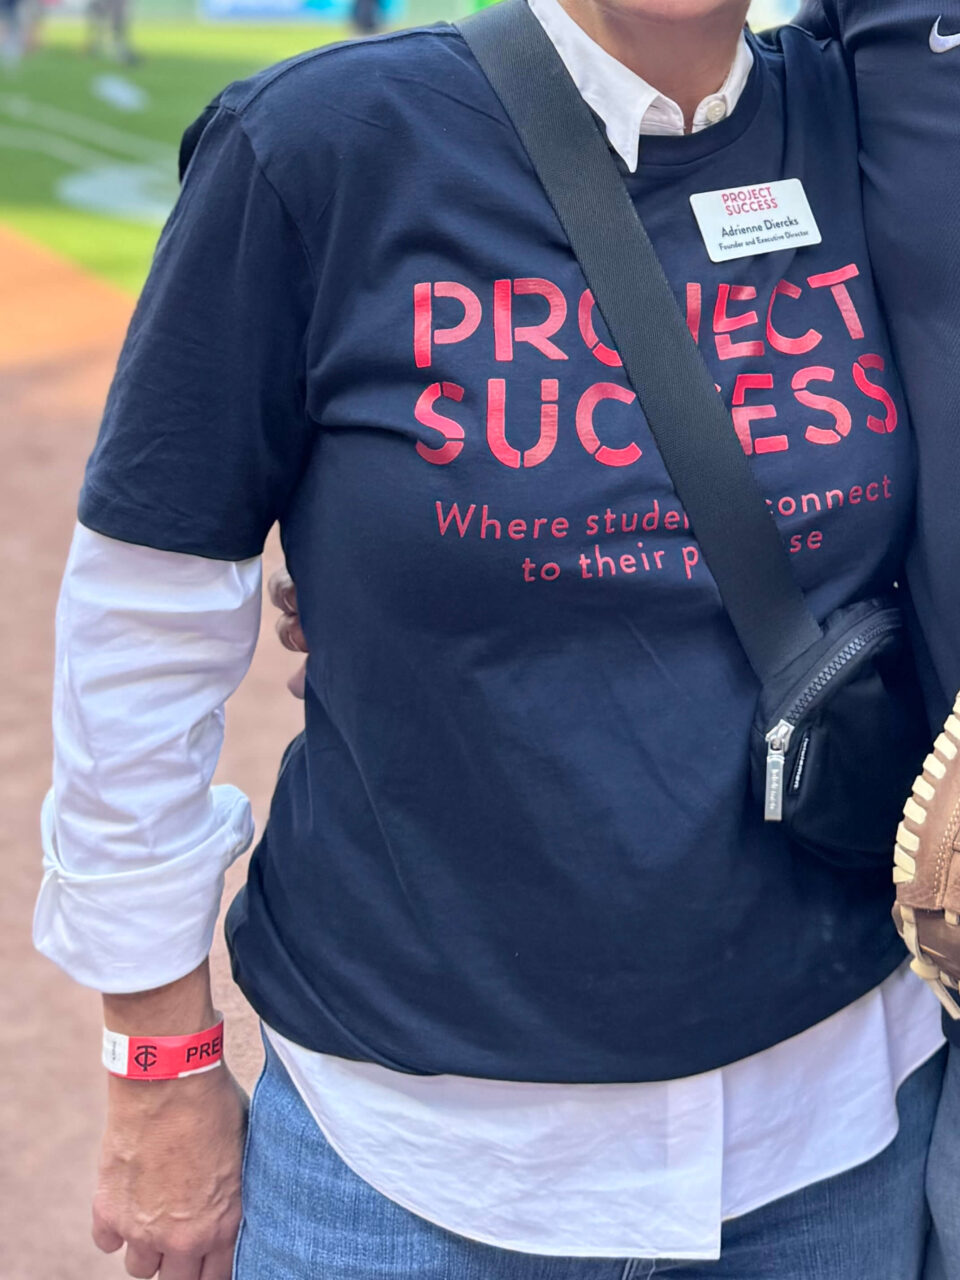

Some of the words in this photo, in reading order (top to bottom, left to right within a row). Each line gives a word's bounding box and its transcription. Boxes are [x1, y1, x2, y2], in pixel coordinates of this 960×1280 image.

[721, 186, 773, 204] PROJECT
[725, 198, 778, 216] SUCCESS
[721, 224, 763, 238] Adrienne
[763, 216, 799, 231] Diercks
[718, 240, 744, 251] Founder
[745, 237, 756, 246] and
[756, 233, 785, 243] Executive
[784, 230, 809, 239] Director
[415, 354, 898, 470] SUCESS
[434, 500, 569, 541] Where
[585, 500, 690, 537] stude
[765, 474, 892, 517] onnect
[522, 556, 561, 582] to
[579, 541, 665, 579] their
